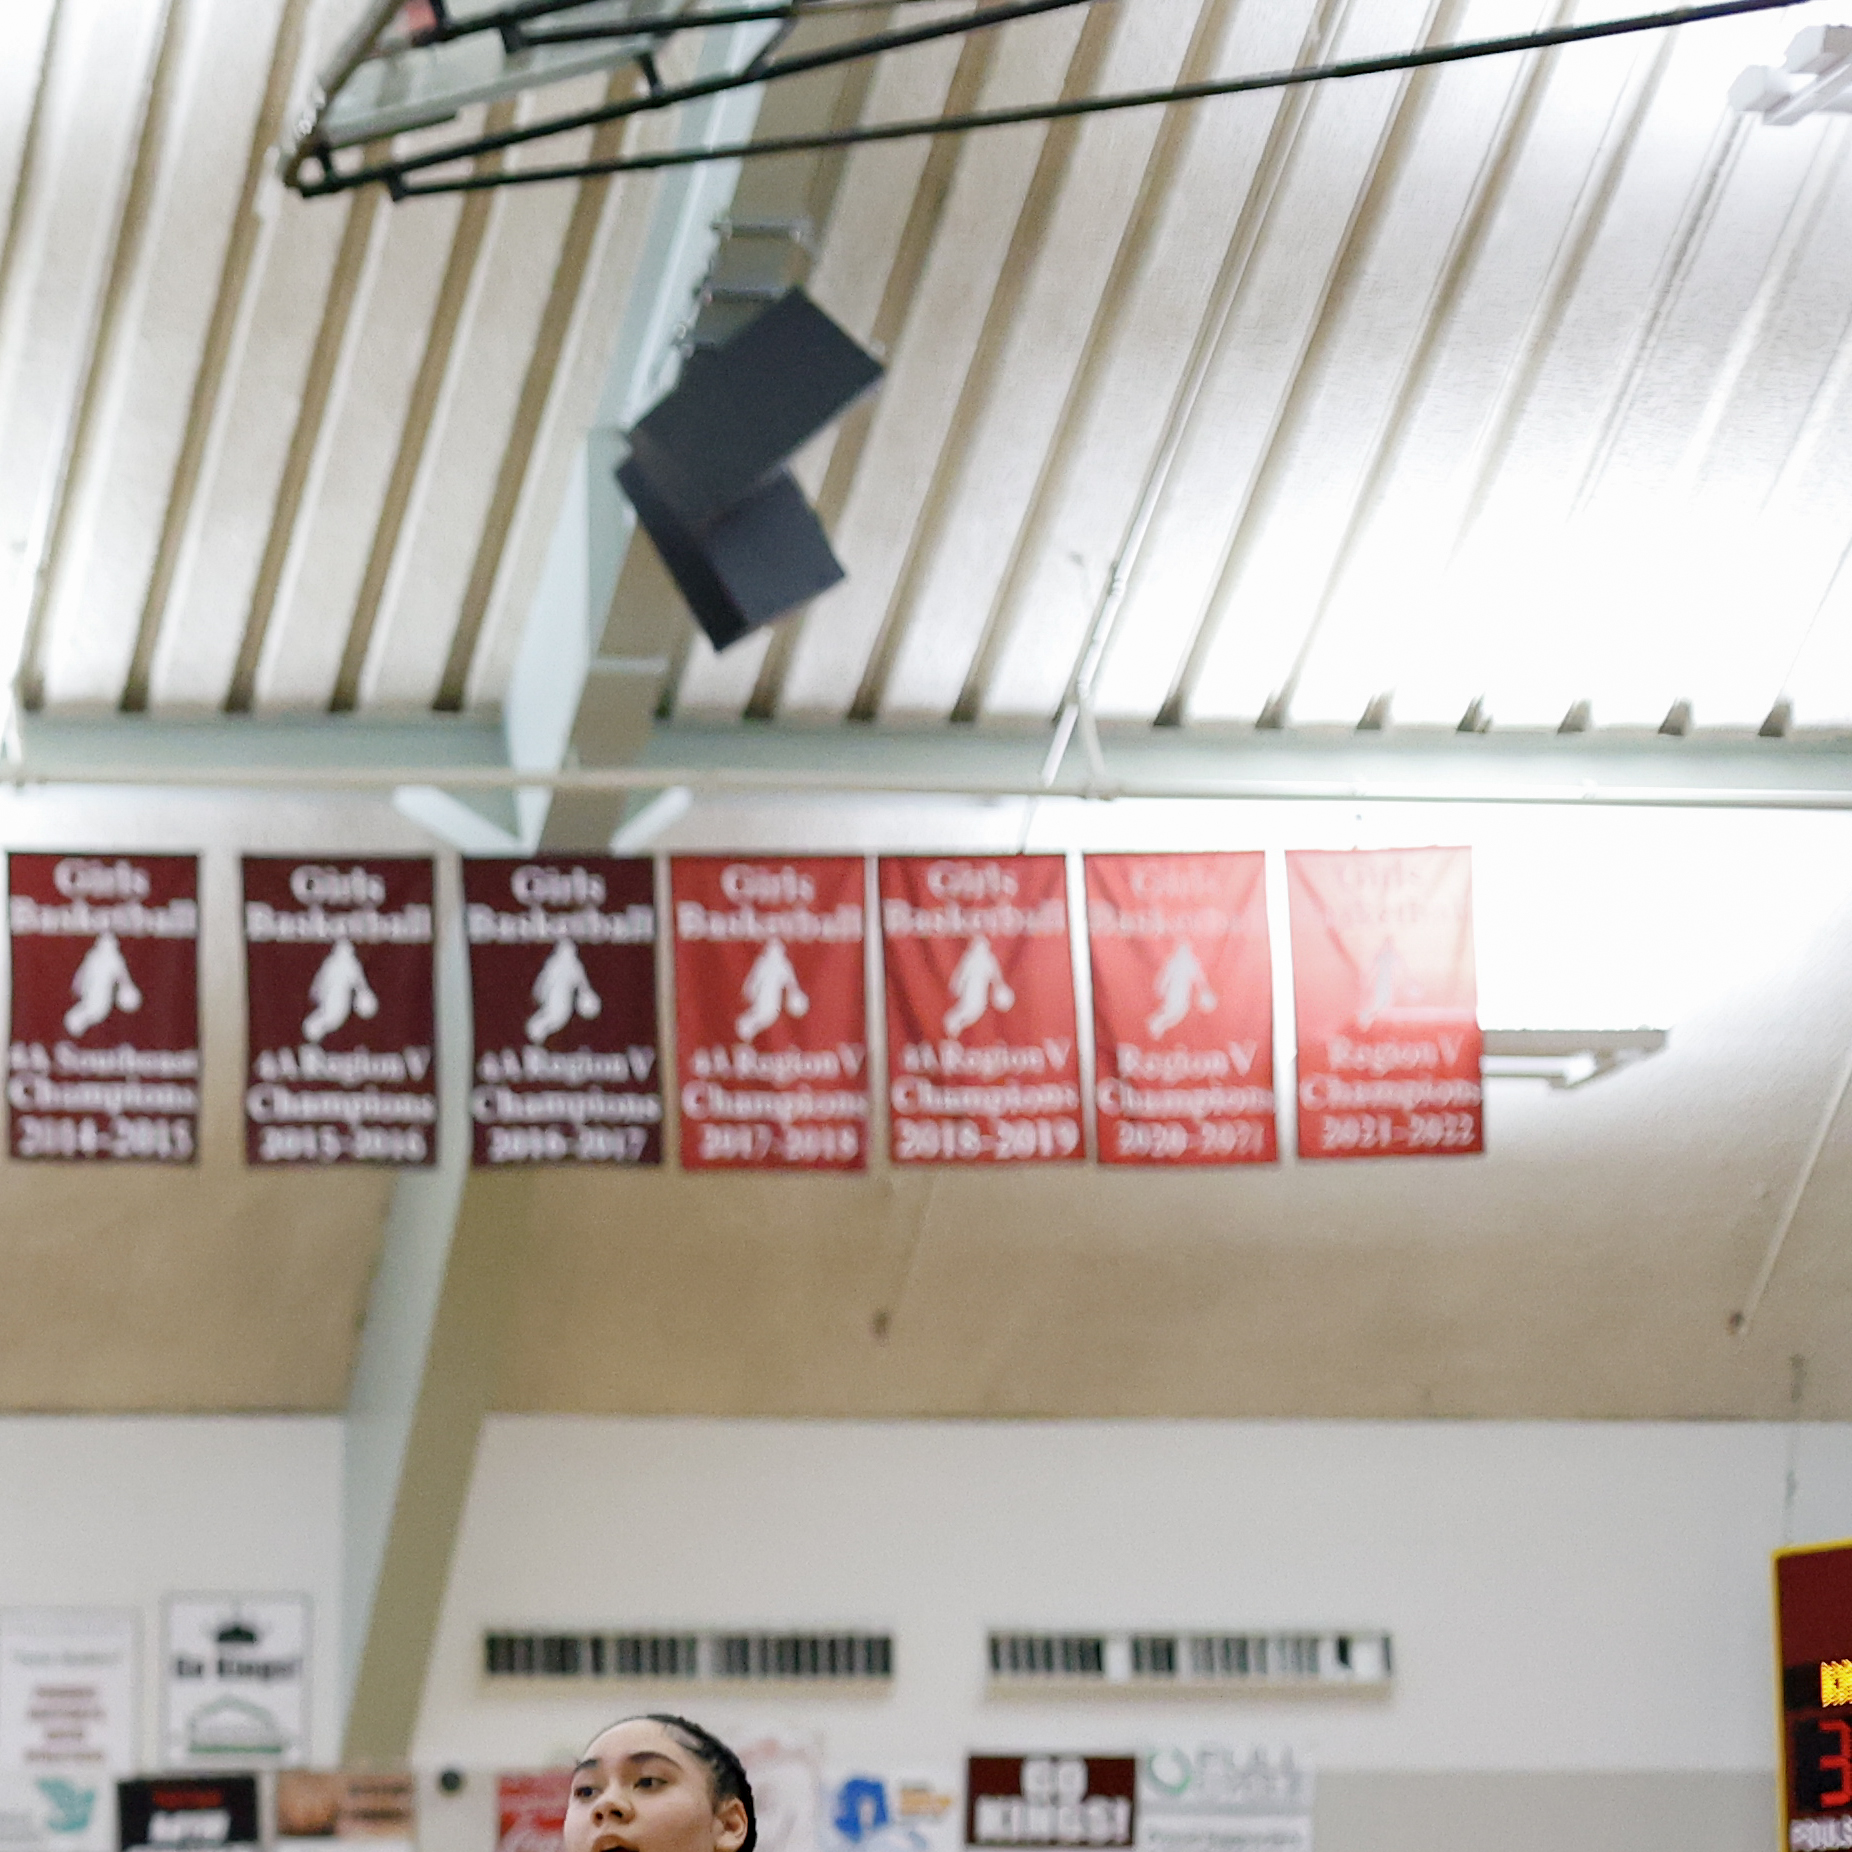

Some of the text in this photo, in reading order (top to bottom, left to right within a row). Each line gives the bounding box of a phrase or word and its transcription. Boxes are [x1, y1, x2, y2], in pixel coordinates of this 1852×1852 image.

[53, 856, 151, 901] Girls
[291, 865, 387, 905] Girls
[510, 865, 607, 905] Girls
[721, 863, 816, 905] Girls
[926, 860, 1020, 900] Girls
[10, 896, 198, 938] Basketball
[246, 901, 433, 943] Basketball
[467, 901, 655, 943] Basketball
[677, 900, 864, 942] Basketball
[884, 898, 1067, 938] Basketball
[300, 1043, 405, 1085] Region
[405, 1045, 432, 1082] V
[523, 1043, 630, 1085] Region
[630, 1045, 656, 1082] V
[732, 1043, 837, 1085] Region
[837, 1043, 865, 1080] V
[940, 1039, 1043, 1082] Region
[1044, 1041, 1072, 1073] V
[1117, 1041, 1258, 1084] Region V
[1327, 1034, 1465, 1076] Region V
[7, 1073, 198, 1115] Champions
[246, 1082, 436, 1131] Champions
[472, 1082, 663, 1131] Champions
[681, 1079, 867, 1130] Champions
[891, 1073, 1080, 1117] Champions
[1097, 1073, 1276, 1118] Champions
[1300, 1071, 1480, 1115] Champions
[1020, 1756, 1088, 1802] GO
[974, 1800, 1131, 1845] KINGS!
